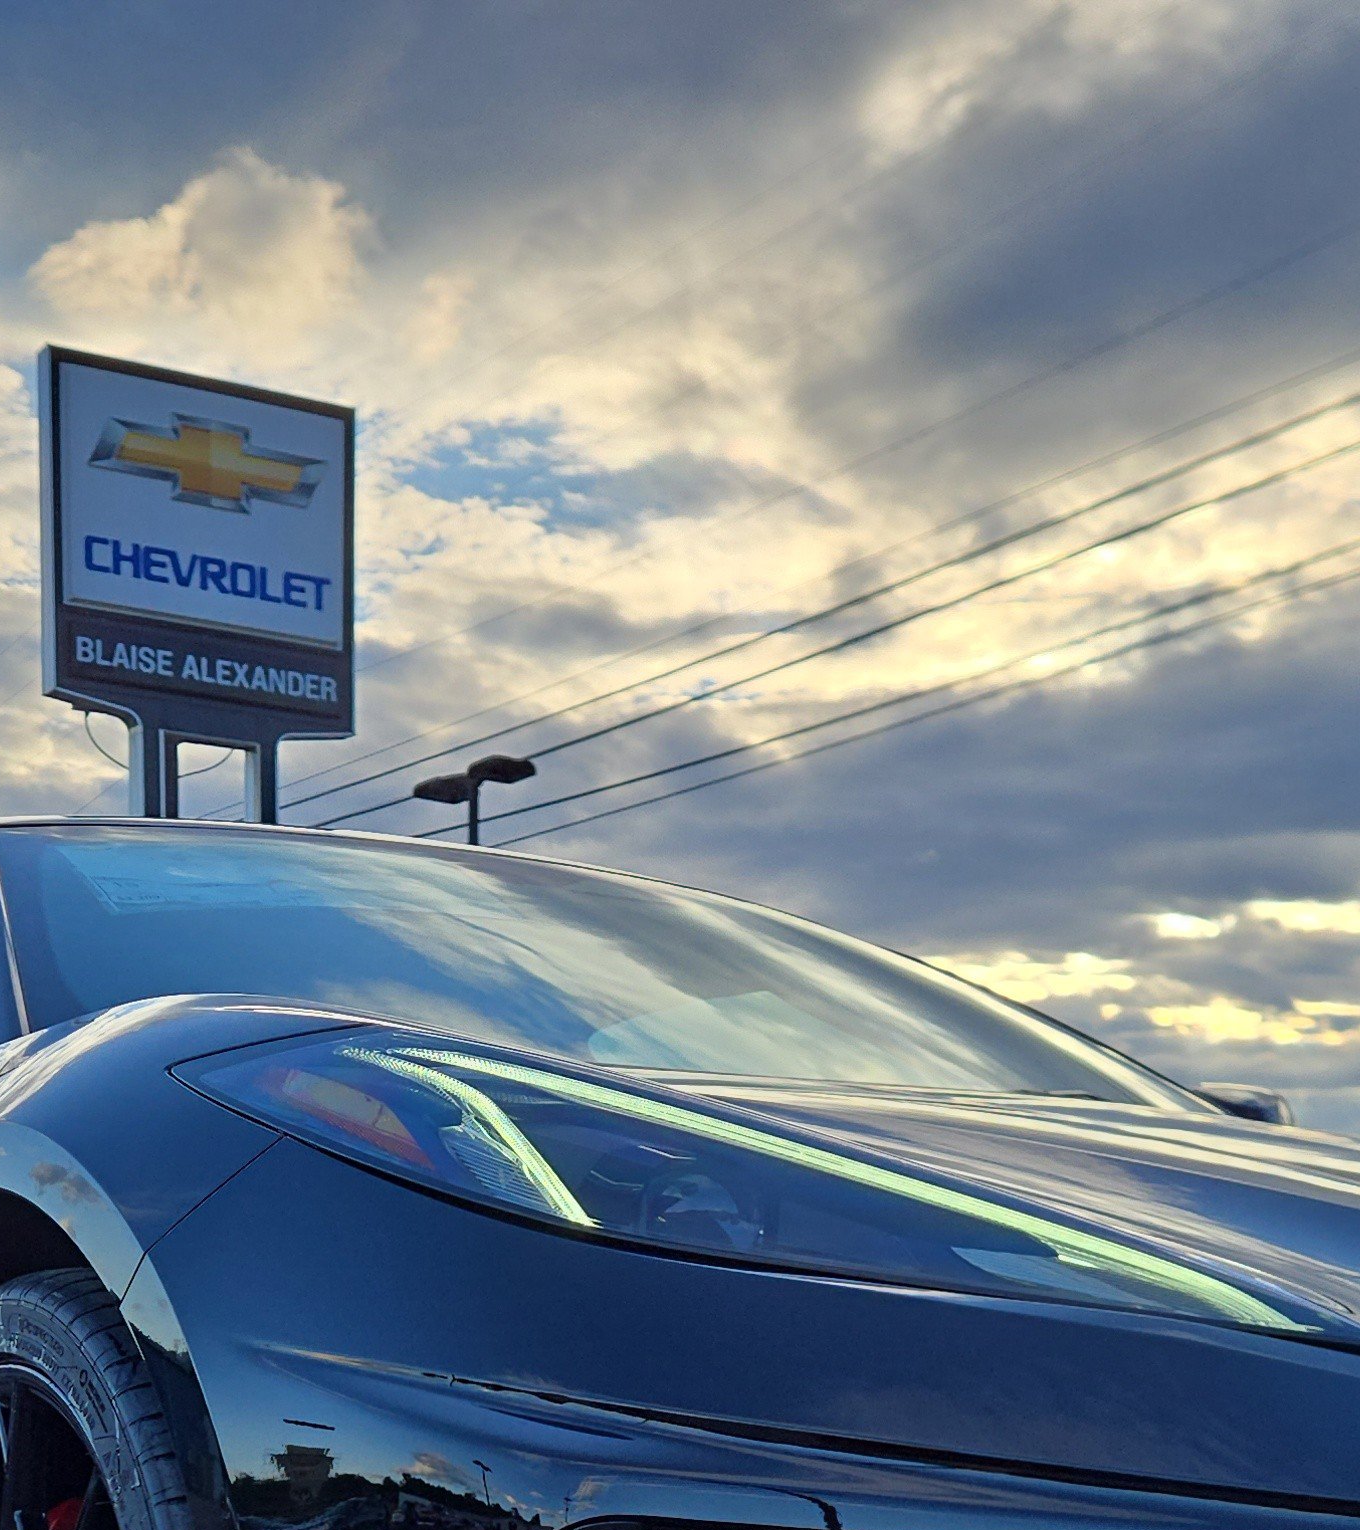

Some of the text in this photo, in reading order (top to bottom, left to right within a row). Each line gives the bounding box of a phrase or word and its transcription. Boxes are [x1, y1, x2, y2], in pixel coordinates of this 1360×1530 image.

[84, 534, 332, 611] CHEVROLET
[75, 635, 338, 702] BLAISE ALEXANDER
